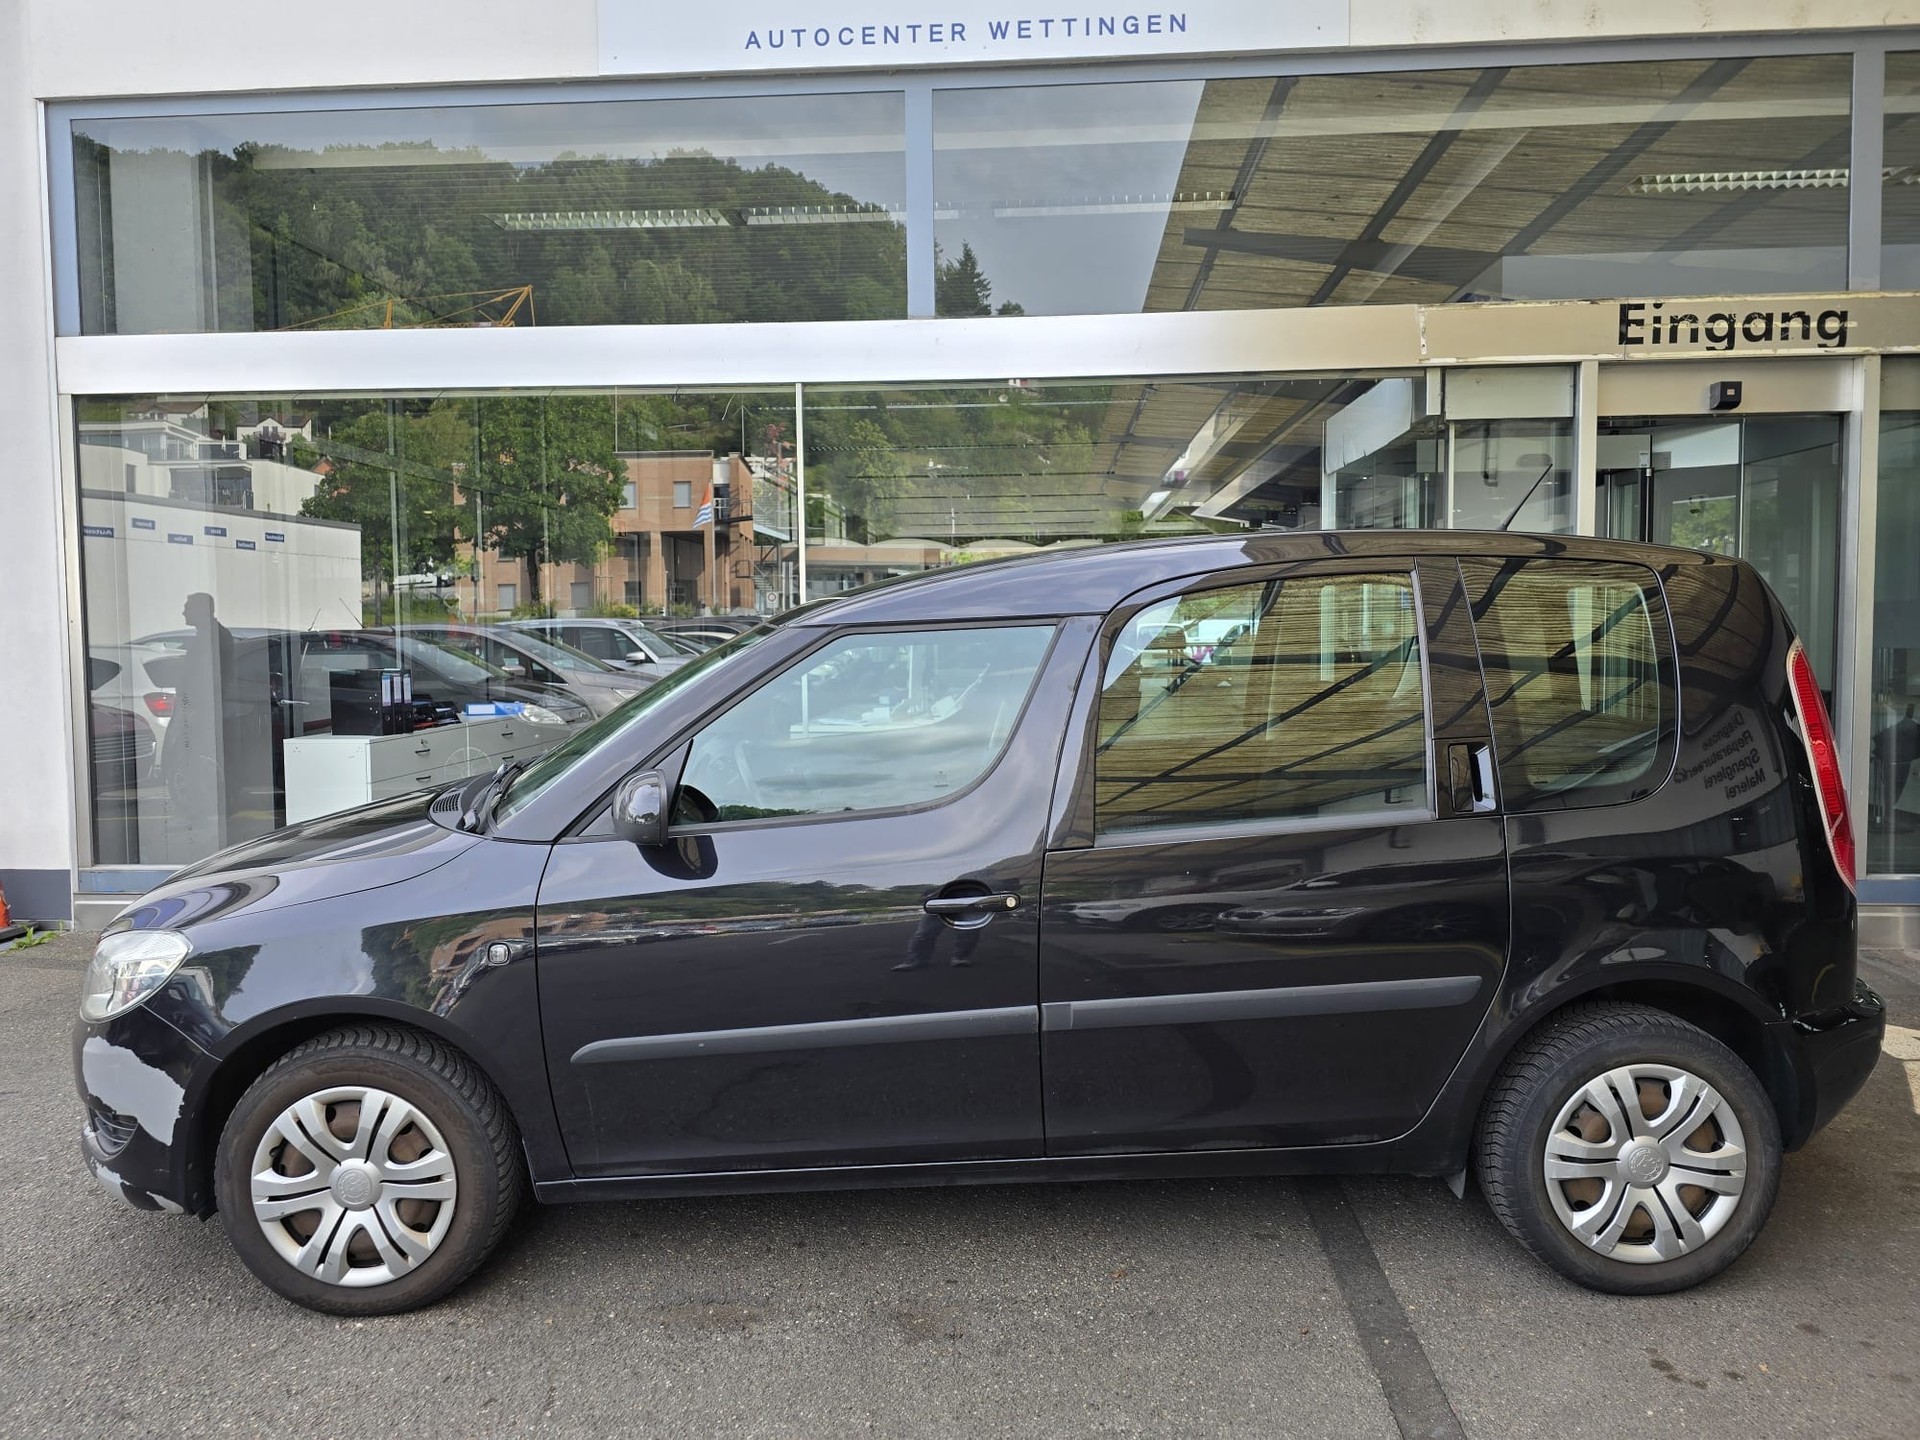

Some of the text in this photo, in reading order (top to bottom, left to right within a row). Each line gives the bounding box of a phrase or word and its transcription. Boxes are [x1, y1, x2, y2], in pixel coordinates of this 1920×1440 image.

[745, 13, 1188, 50] AUTOCENTER WETTINGEN
[1618, 302, 1849, 351] Eingang
